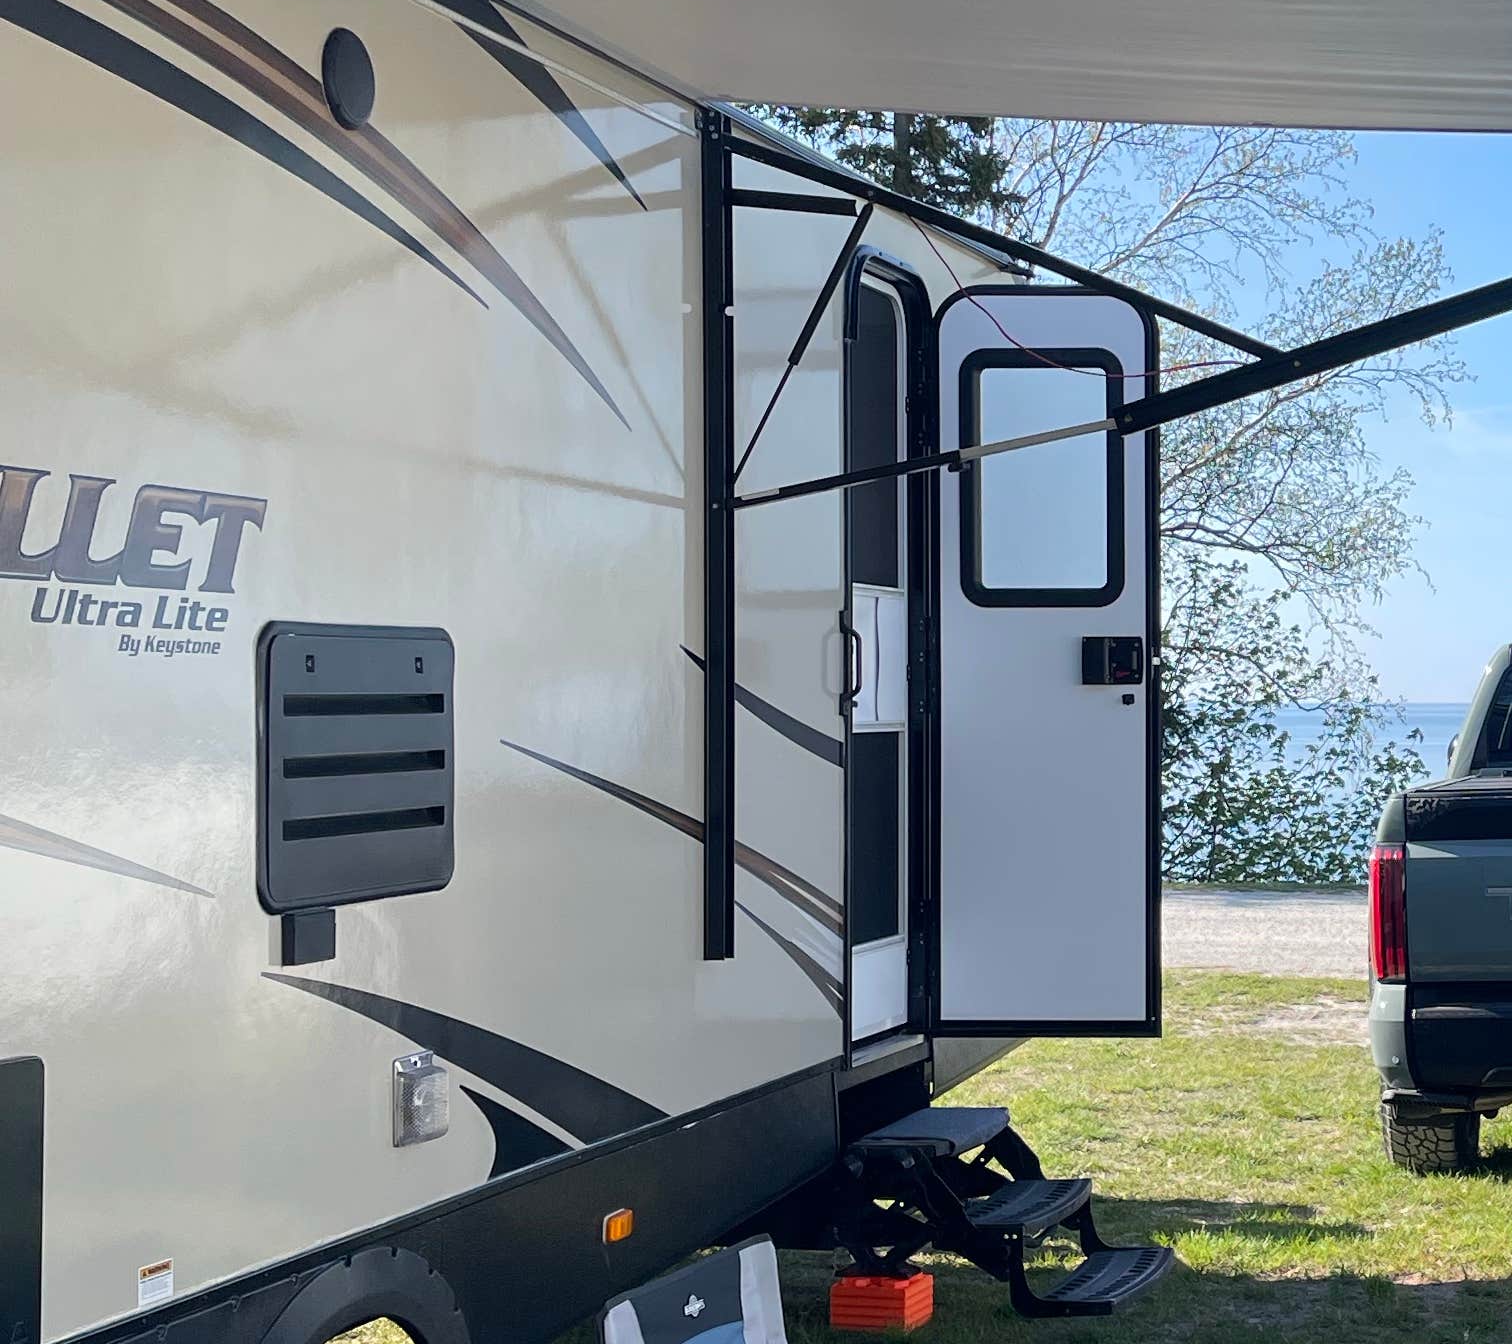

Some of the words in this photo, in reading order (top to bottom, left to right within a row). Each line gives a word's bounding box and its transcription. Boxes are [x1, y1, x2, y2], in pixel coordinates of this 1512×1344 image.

[30, 586, 143, 628] Ultra
[152, 595, 229, 633] Lite
[117, 634, 141, 657] By
[144, 635, 221, 658] Keystone
